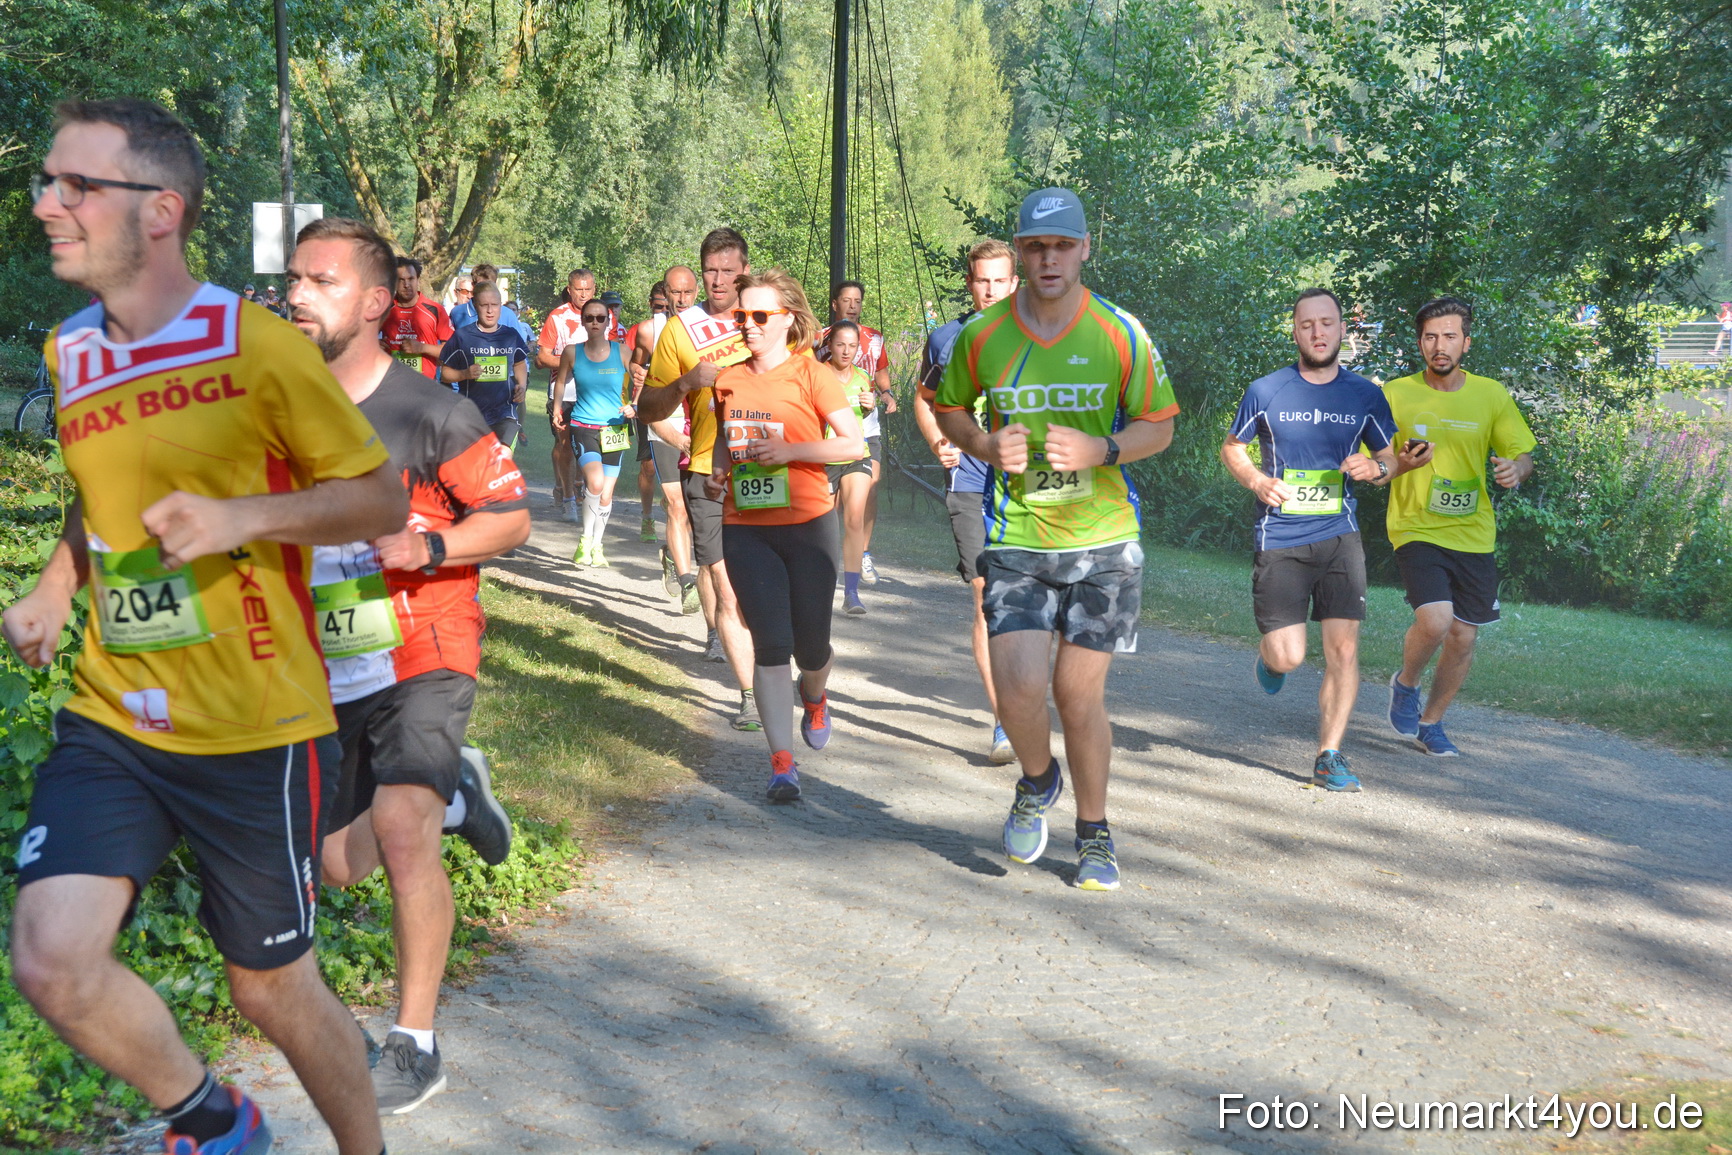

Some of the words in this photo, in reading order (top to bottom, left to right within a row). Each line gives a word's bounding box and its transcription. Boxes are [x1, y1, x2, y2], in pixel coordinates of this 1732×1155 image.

[1038, 197, 1065, 210] NIKE
[470, 347, 490, 355] EURO
[699, 343, 739, 363] MAX
[482, 365, 502, 375] 492
[989, 383, 1109, 414] BOCK
[60, 401, 128, 450] MAX
[136, 373, 247, 419] BÖGL
[730, 409, 743, 419] 30
[745, 409, 772, 421] Jahre
[1279, 411, 1313, 422] EURO
[1323, 412, 1357, 425] POLES
[605, 433, 625, 445] 2027
[741, 478, 774, 497] 895
[1036, 470, 1080, 490] 234
[1296, 486, 1330, 502] 522
[1440, 492, 1471, 507] 953
[109, 582, 182, 623] 204
[325, 607, 356, 636] 47
